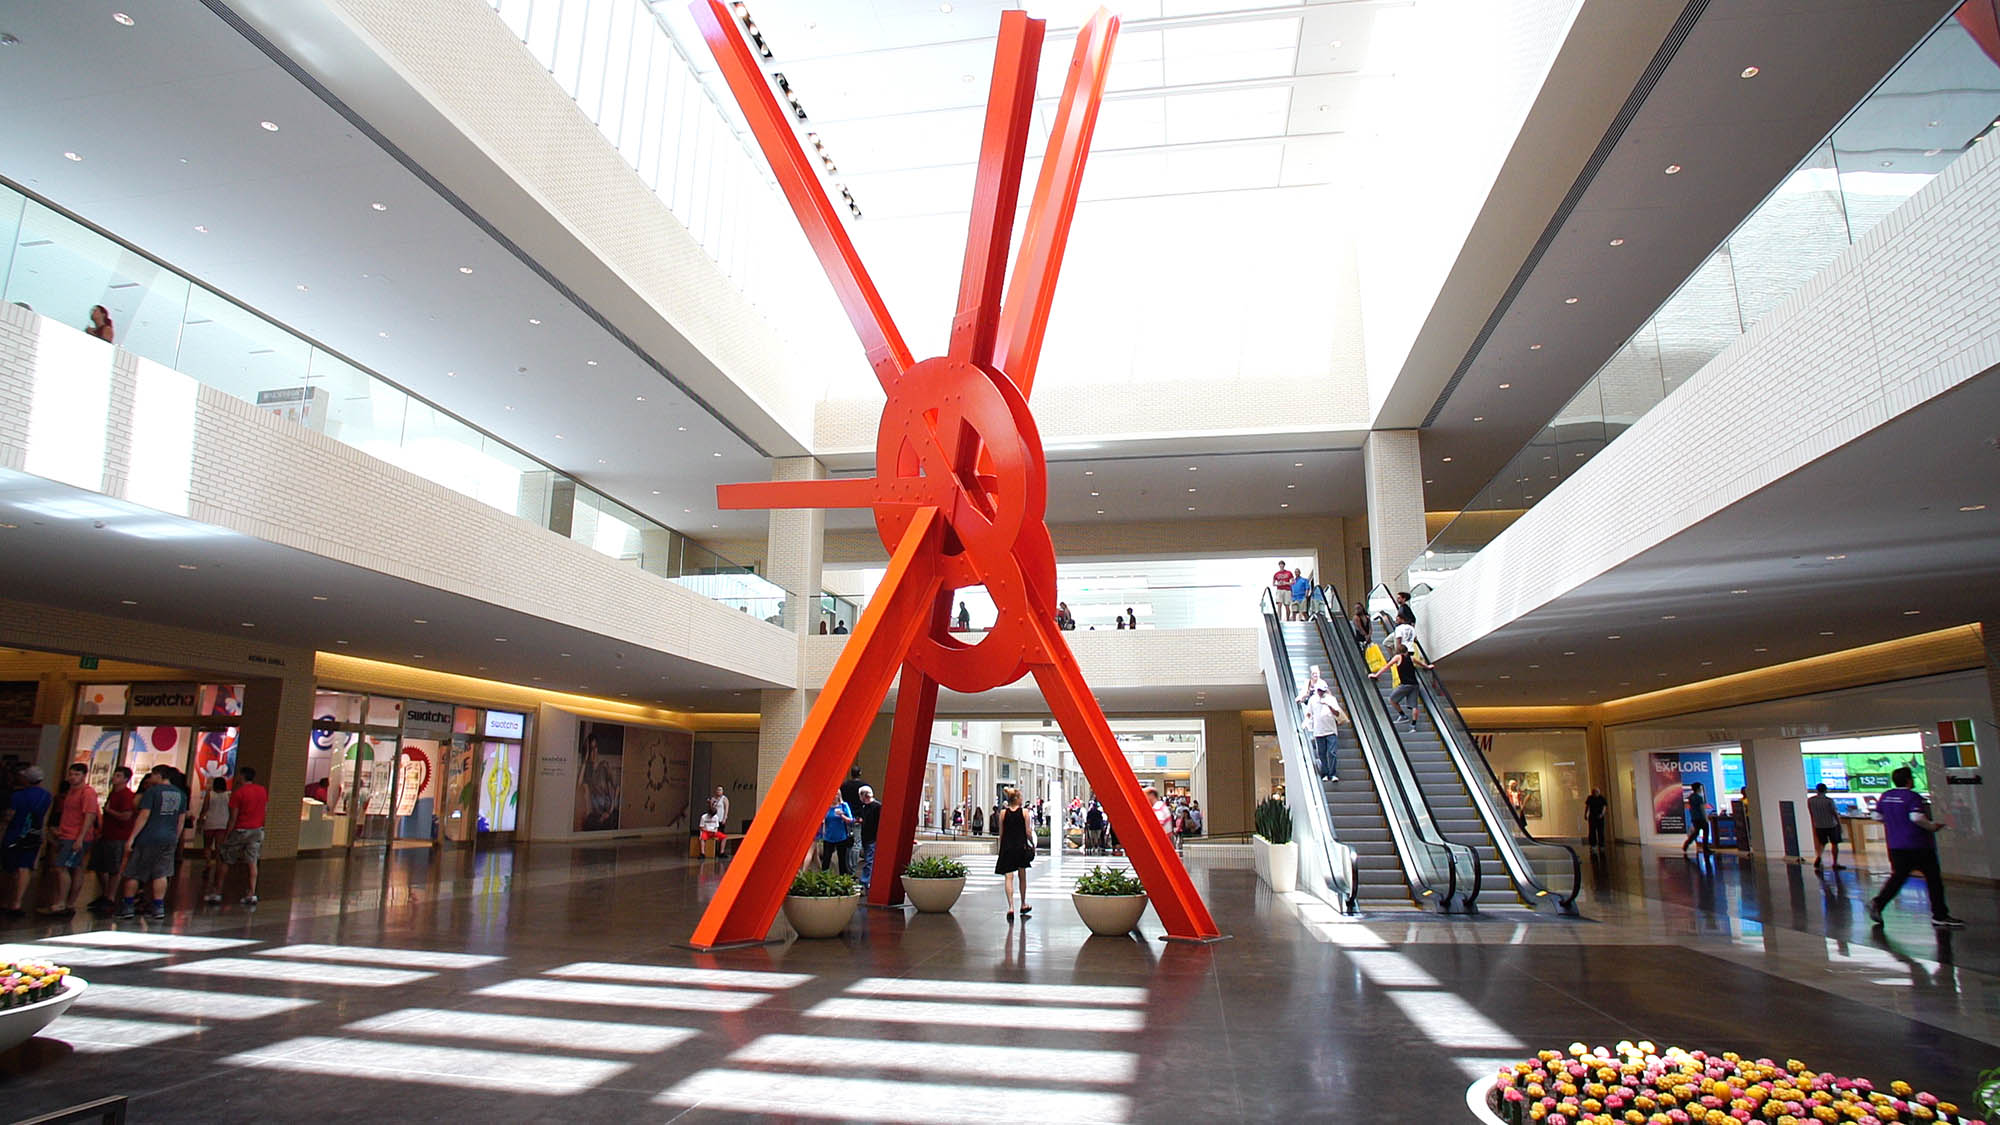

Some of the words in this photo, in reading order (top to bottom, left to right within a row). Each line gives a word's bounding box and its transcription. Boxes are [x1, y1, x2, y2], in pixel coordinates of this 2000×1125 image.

[134, 693, 185, 706] swatch
[408, 709, 444, 723] swatch
[490, 719, 514, 730] swatch
[1655, 761, 1709, 773] EXPLORE
